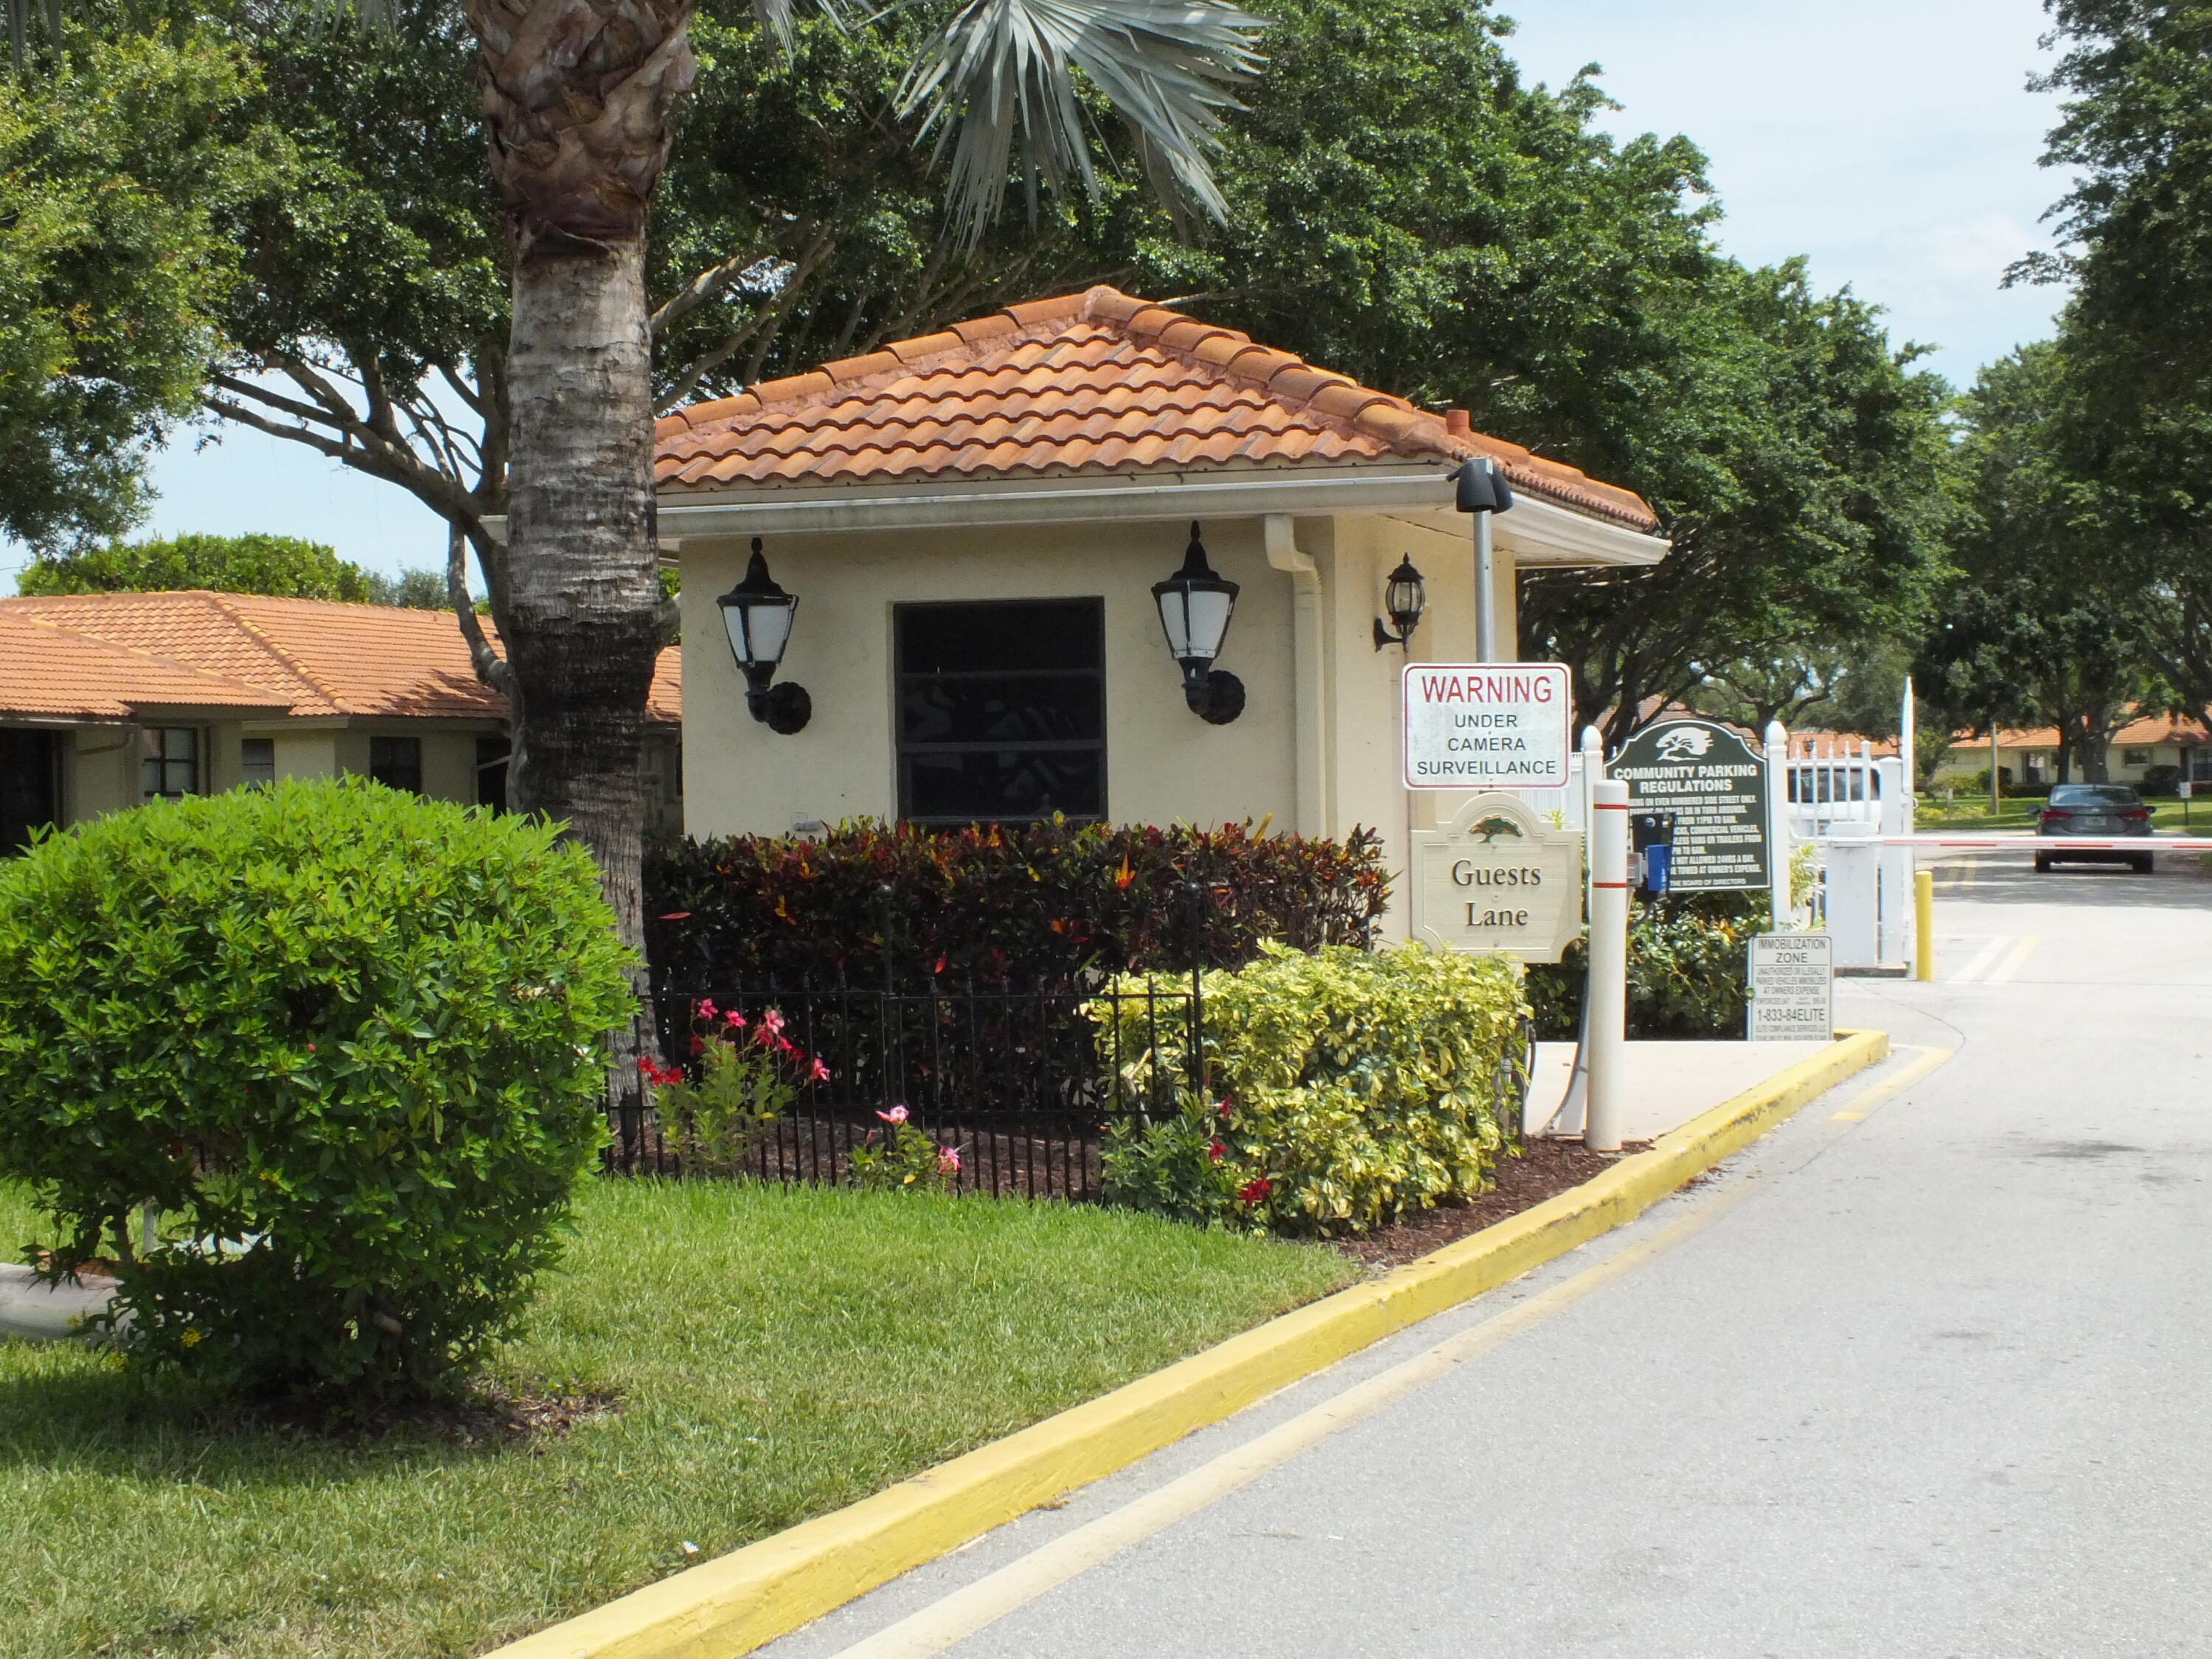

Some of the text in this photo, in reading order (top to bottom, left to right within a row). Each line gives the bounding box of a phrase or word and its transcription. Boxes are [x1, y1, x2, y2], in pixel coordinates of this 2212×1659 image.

[1422, 675, 1552, 703] WARNING
[1455, 714, 1517, 728] UNDER
[1448, 737, 1526, 751] CAMERA
[1416, 760, 1557, 775] SURVEILLANCE
[1613, 764, 1758, 780] COMMUNITY PARKING
[1640, 779, 1733, 793] REGULATIONS
[1655, 797, 1670, 806] EVEN
[1719, 795, 1740, 804] STREET
[1677, 816, 1695, 825] FROM
[1714, 815, 1721, 824] TO
[1690, 825, 1729, 835] COMMERCIAL
[1717, 835, 1743, 844] TRAILERS
[1744, 834, 1763, 843] FROM
[1683, 846, 1691, 855] TO
[1689, 855, 1717, 864] ALLOWED
[1736, 855, 1742, 863] A
[1451, 858, 1542, 886] Guests
[1677, 866, 1698, 874] TOWED
[1699, 866, 1706, 874] AT
[1465, 901, 1528, 927] Lane
[1759, 939, 1826, 950] IMMOBILIZATION
[1775, 953, 1808, 963] ZONE
[1801, 967, 1825, 975] ILLEGALLY
[1756, 977, 1774, 985] PARKED
[1776, 977, 1797, 985] VEHICLES
[1771, 987, 1794, 995] OWNERS
[1795, 986, 1820, 995] EXPENSE
[1758, 1009, 1825, 1021] 1-833-84ELITE
